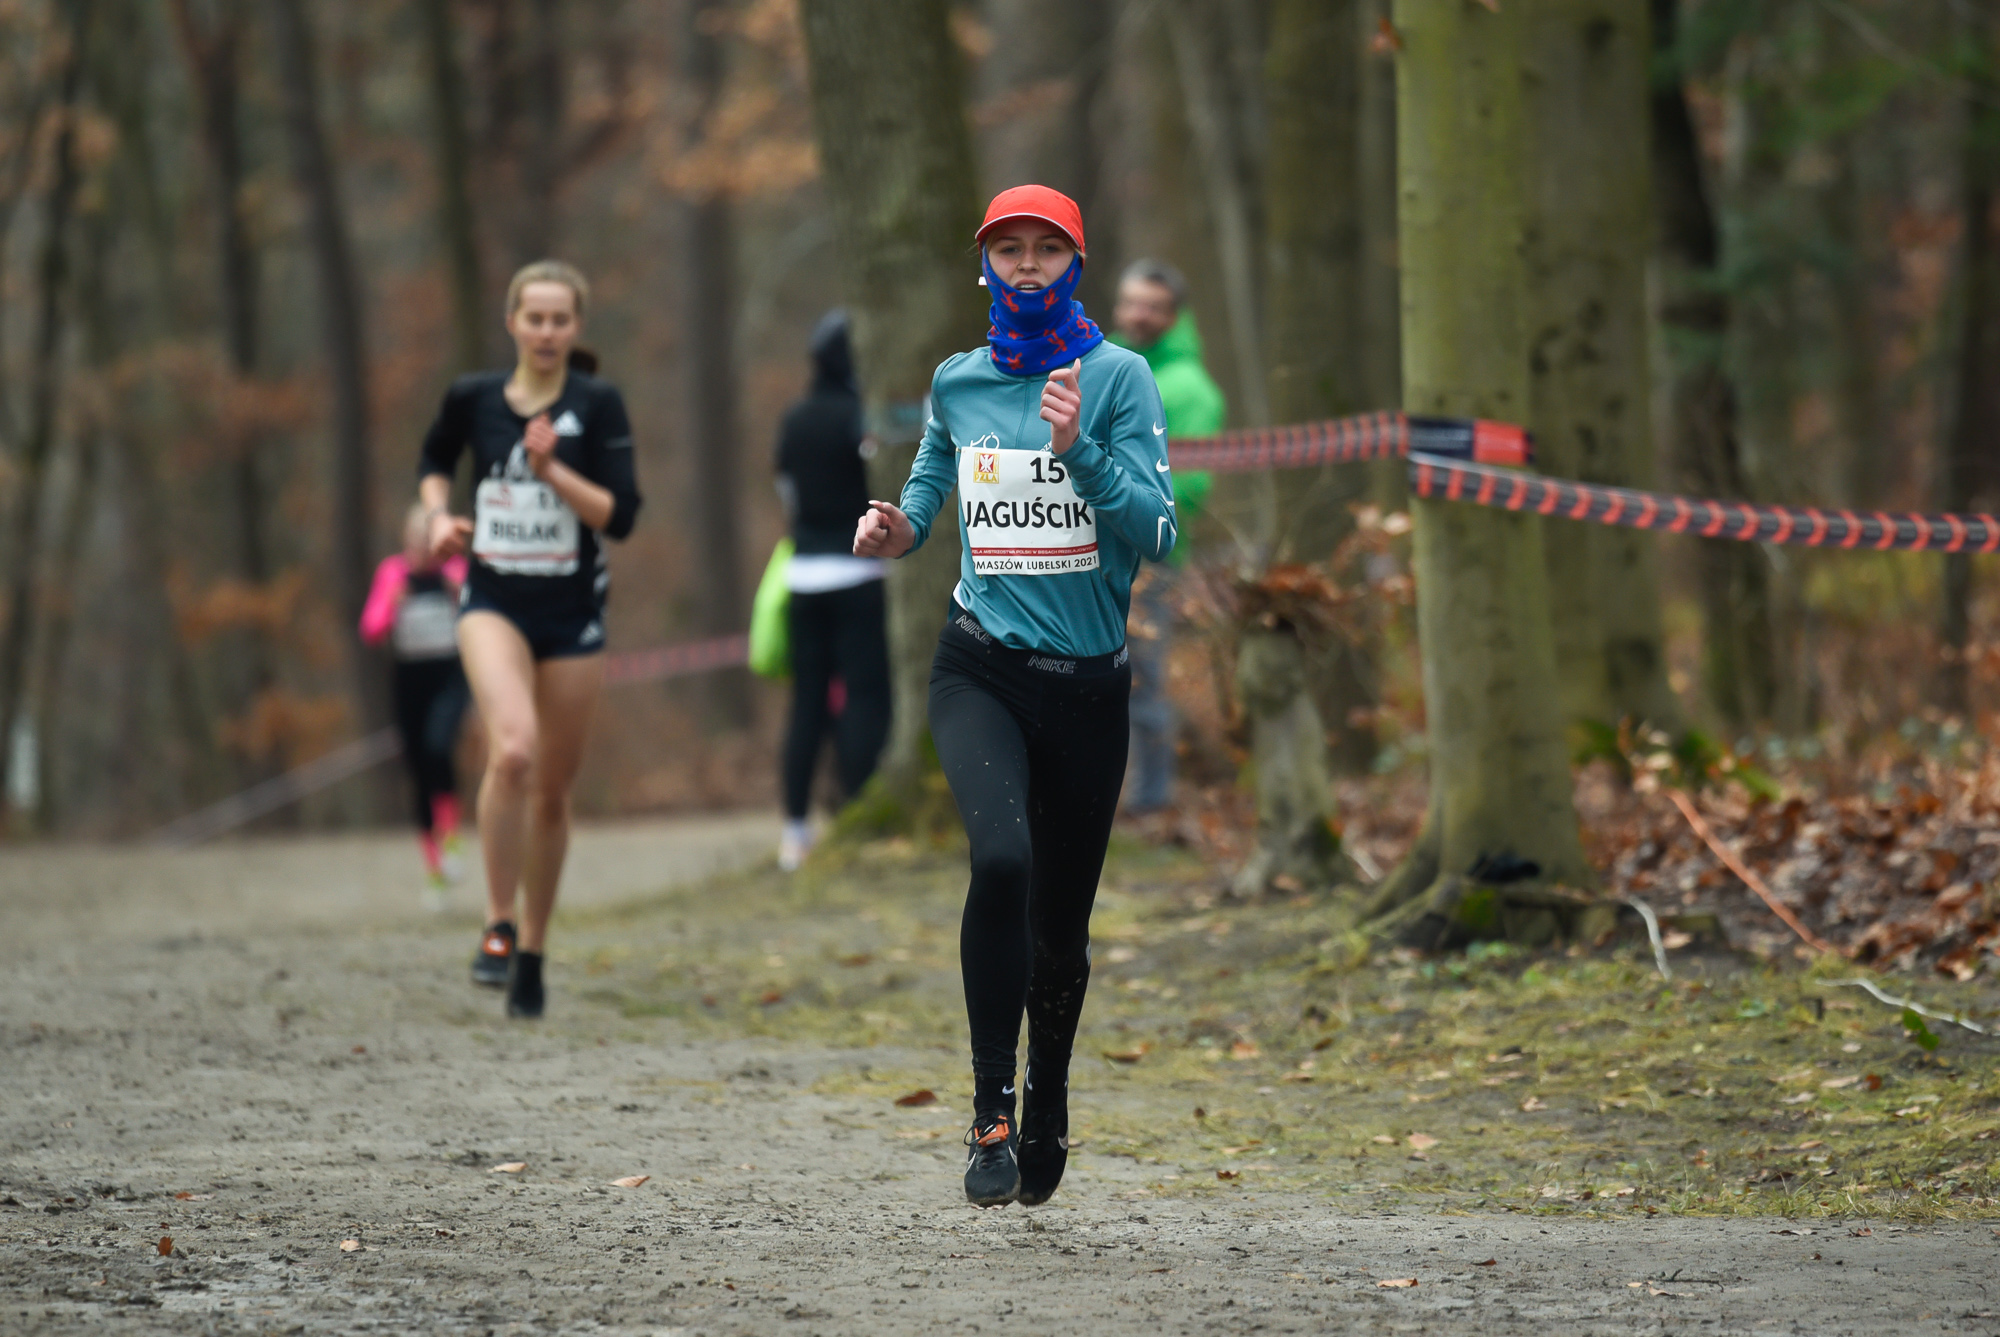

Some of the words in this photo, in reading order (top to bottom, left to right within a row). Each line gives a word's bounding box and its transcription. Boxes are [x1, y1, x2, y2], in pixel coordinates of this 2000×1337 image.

[973, 472, 998, 482] PZLA
[1030, 457, 1071, 484] 15
[965, 496, 1092, 528] JAGUŚCIK
[973, 558, 1023, 570] MASZÓW
[1026, 559, 1071, 569] LUBELSKI
[1074, 555, 1097, 568] 2021
[955, 614, 993, 646] NIKE
[1027, 655, 1076, 675] NIKE
